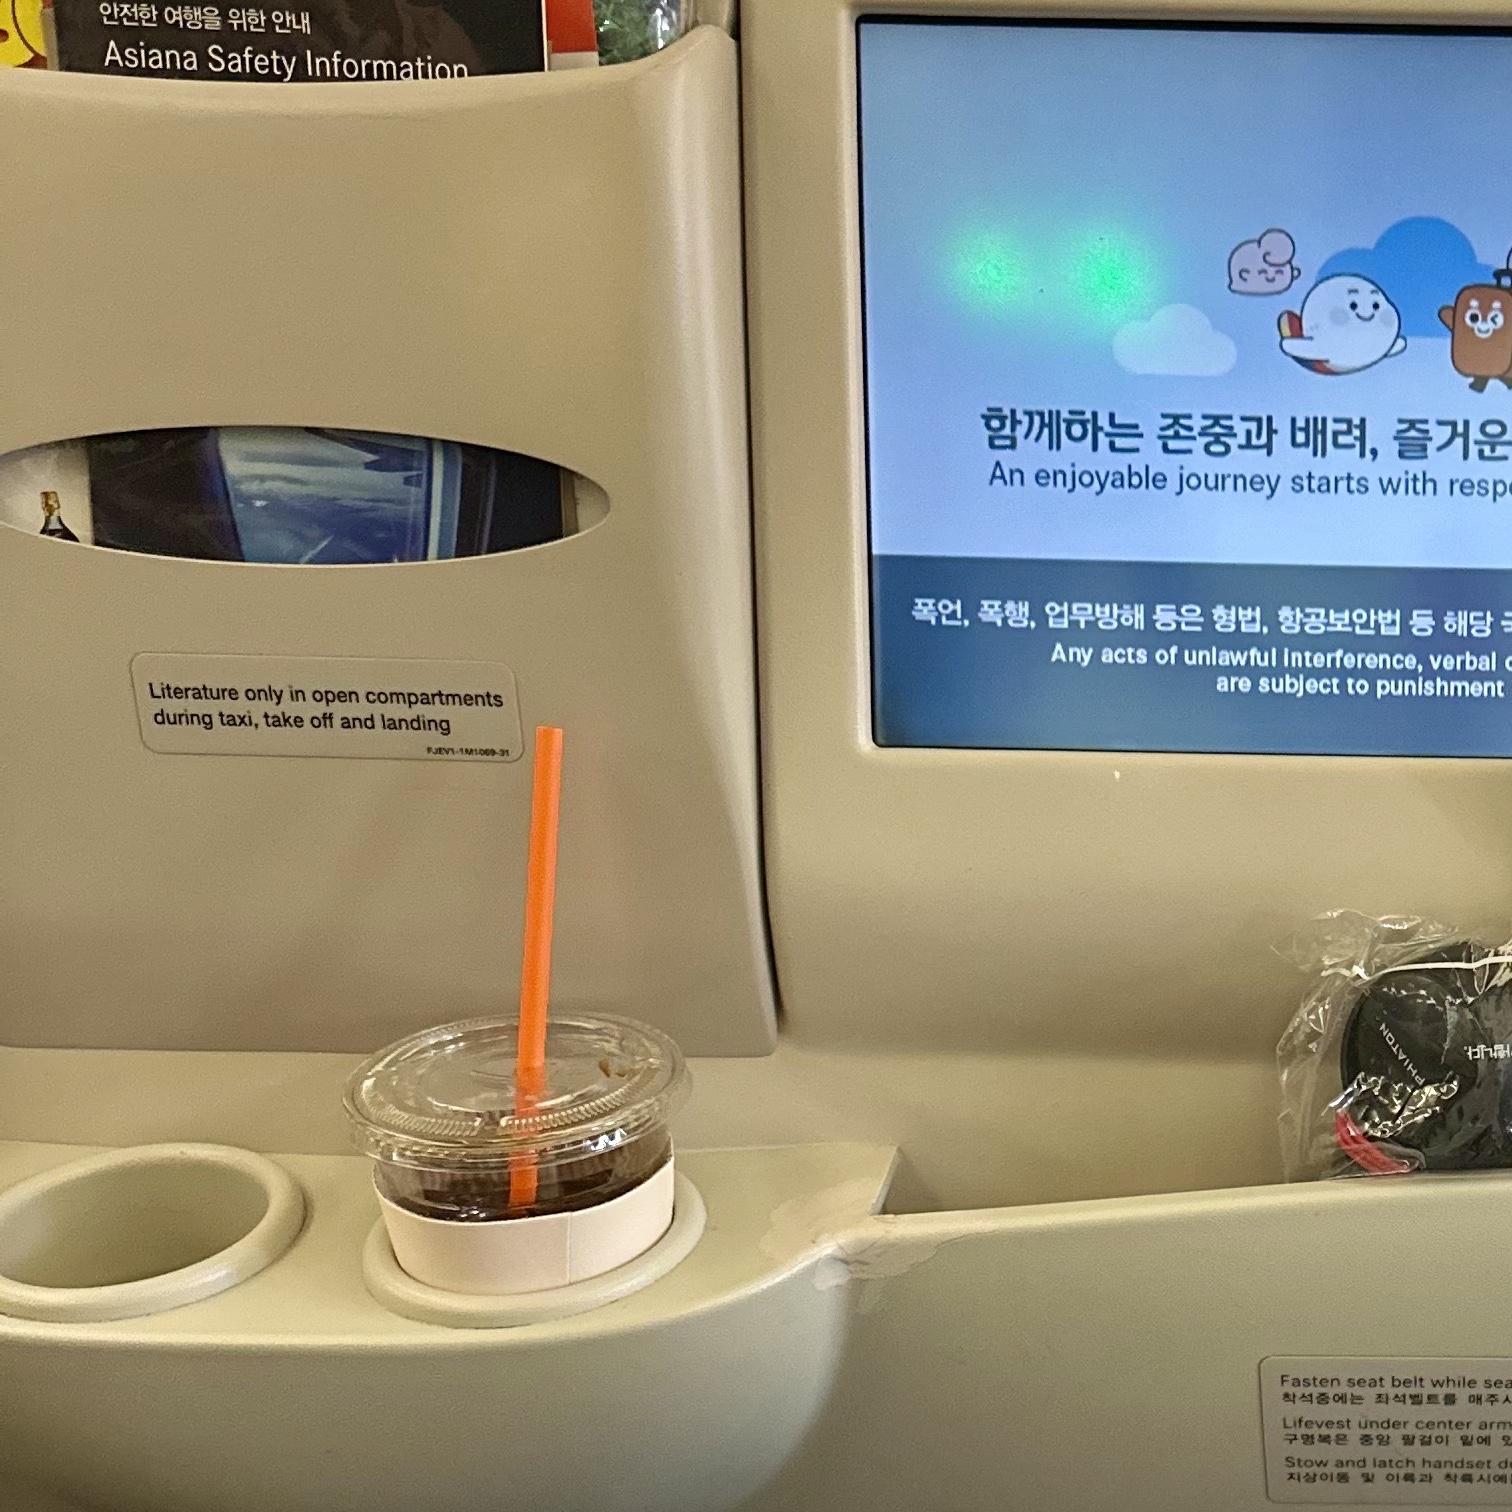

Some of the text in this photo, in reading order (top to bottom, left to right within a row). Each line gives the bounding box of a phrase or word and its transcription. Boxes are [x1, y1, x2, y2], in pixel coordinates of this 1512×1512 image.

[100, 1, 311, 35] 안전한 여행을 위한 안내
[104, 40, 469, 82] Asiana Safety Information
[981, 406, 1144, 454] 함께하는
[1156, 411, 1278, 458] 존중과
[1290, 415, 1378, 461] 배려,
[1393, 417, 1512, 462] 즐거운
[989, 461, 1025, 487] An
[1034, 462, 1168, 496] enjoyable
[1175, 465, 1280, 500] journey
[1291, 469, 1369, 495] starts
[1379, 470, 1437, 496] with
[912, 598, 970, 627] 폭언,
[978, 600, 1036, 630] 폭행,
[1045, 602, 1145, 631] 업무방해
[1153, 604, 1204, 632] 등은
[1212, 604, 1268, 634] 형법,
[1278, 606, 1401, 636] 항공보안법
[1409, 609, 1435, 637] 등
[1443, 609, 1494, 637] 해당
[1051, 642, 1093, 667] Any
[1101, 647, 1147, 665] acts
[1155, 646, 1178, 665] of
[1184, 646, 1276, 668] unlawful
[1283, 648, 1424, 674] interference,
[1429, 651, 1497, 672] verbal
[149, 682, 504, 710] Literature only in open compartments
[1217, 675, 1252, 692] are
[1258, 673, 1339, 698] subject
[1346, 677, 1369, 694] to
[1376, 676, 1505, 699] punishment
[154, 710, 451, 736] during taxi, take off and landing
[1379, 1022, 1425, 1086] PHIATON
[1280, 1374, 1341, 1389] Fasten
[1346, 1376, 1385, 1389] seat
[1391, 1375, 1424, 1389] belt
[1430, 1376, 1478, 1389] while
[1282, 1392, 1365, 1406] 착석중에는
[1375, 1393, 1458, 1407] 좌석벨트를
[1282, 1417, 1351, 1430] Lifevest
[1358, 1418, 1409, 1430] under
[1414, 1419, 1473, 1431] center
[1284, 1433, 1349, 1446] 구명복은
[1359, 1433, 1391, 1447] 중앙
[1401, 1434, 1450, 1447] 팔걸이
[1284, 1456, 1329, 1469] Stow
[1334, 1456, 1367, 1469] and
[1373, 1456, 1416, 1469] latch
[1422, 1457, 1492, 1470] handset
[1286, 1472, 1350, 1484] 지상이동
[1386, 1472, 1433, 1485] 이륙과
